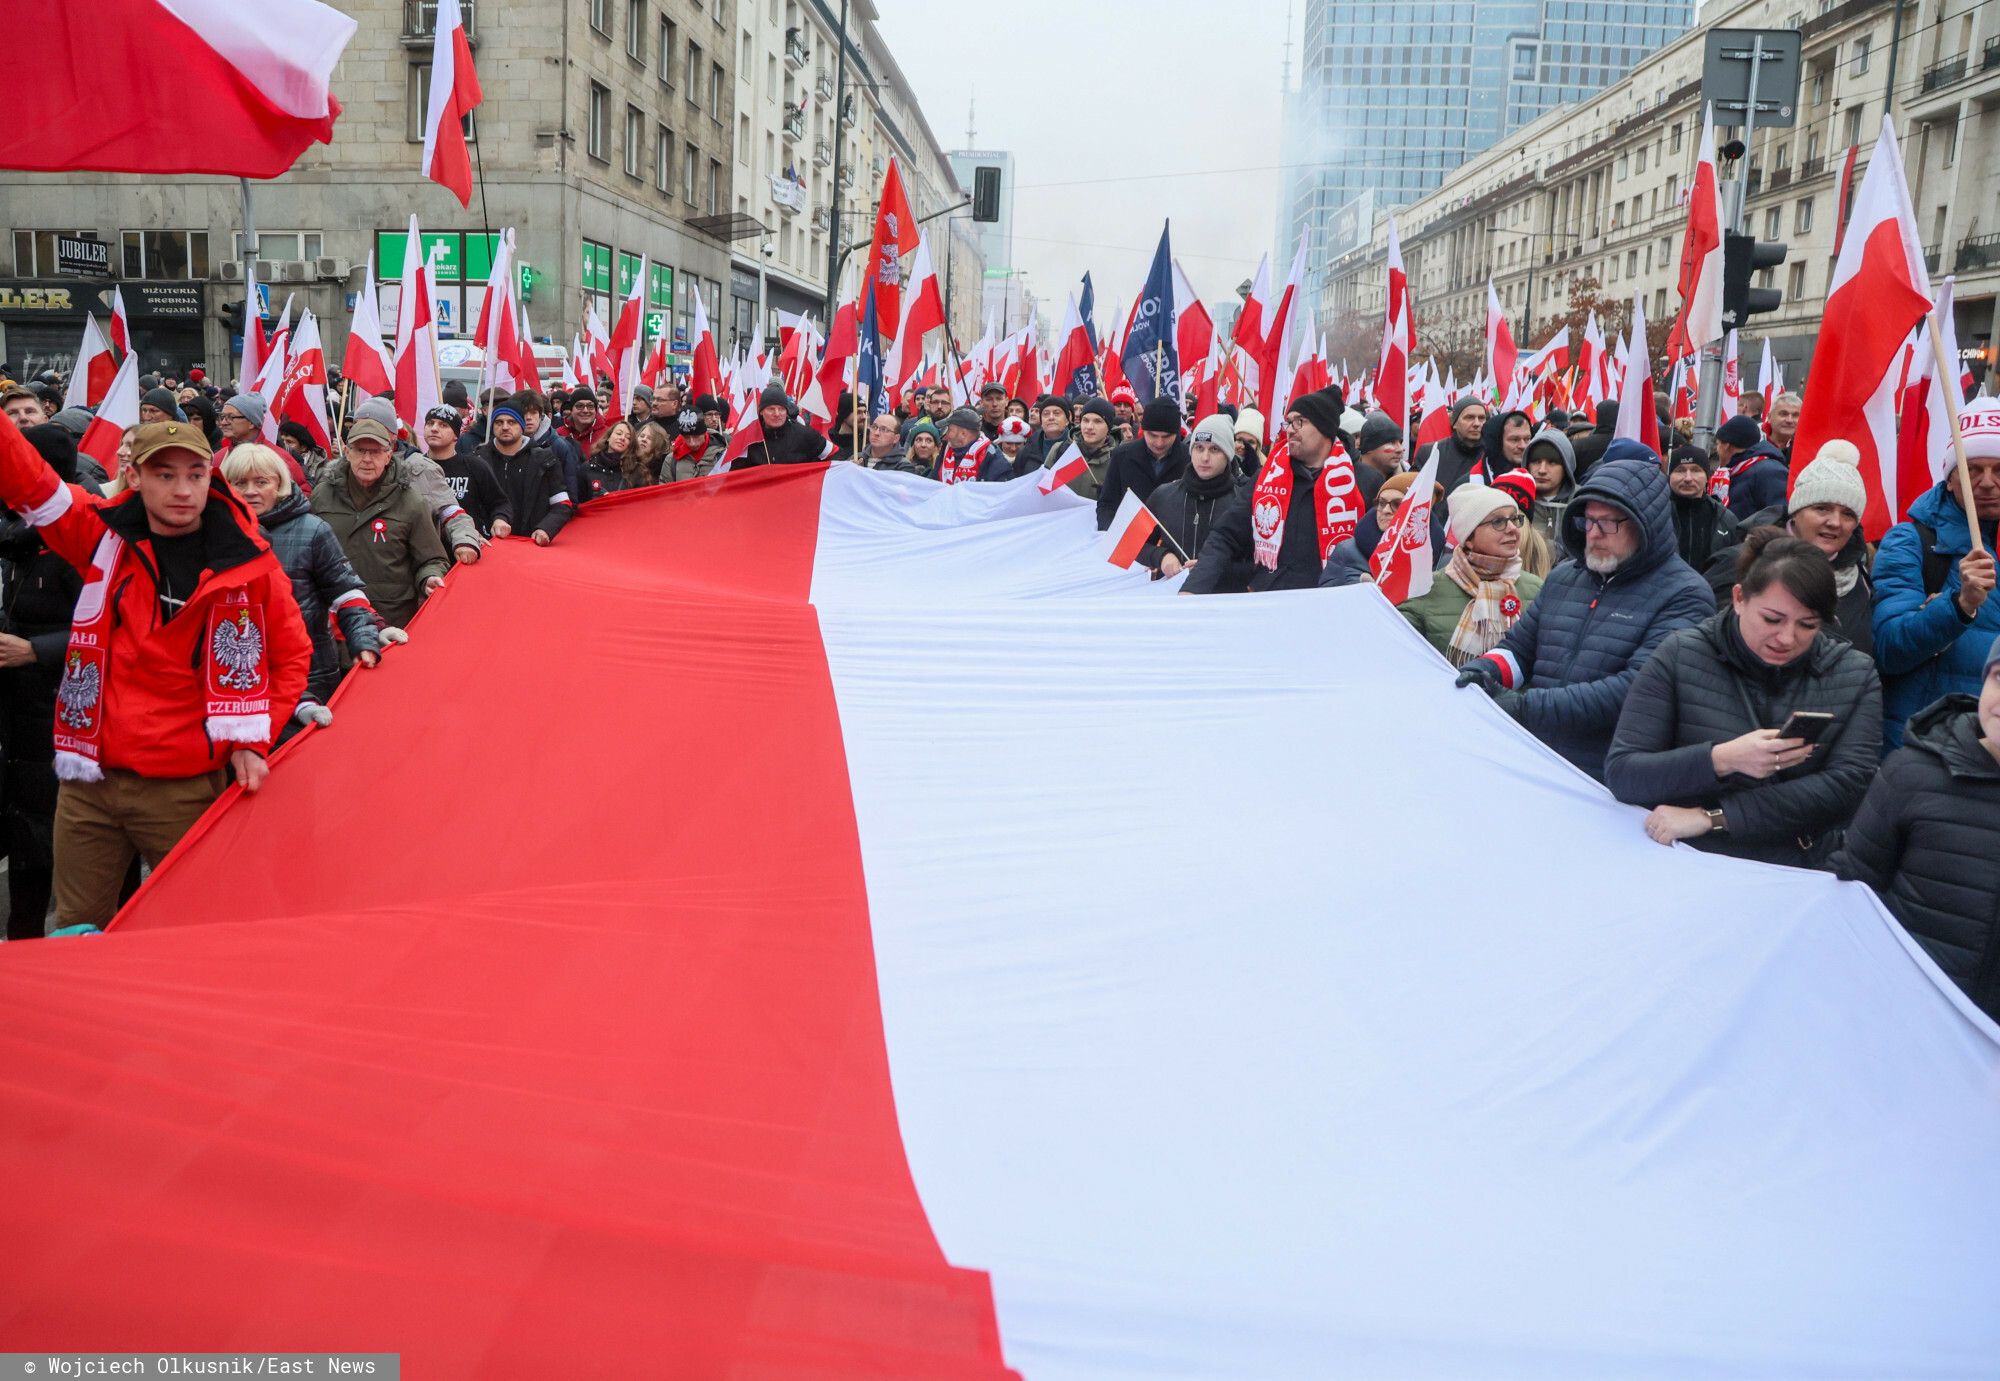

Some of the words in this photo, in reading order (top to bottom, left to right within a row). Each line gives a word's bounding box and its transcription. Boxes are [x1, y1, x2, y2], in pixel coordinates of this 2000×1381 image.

[60, 239, 108, 263] JUBILER
[142, 287, 198, 295] BIŻUTERIA
[152, 306, 198, 314] ZEGARKI
[1321, 524, 1354, 536] BIAŁ
[70, 630, 98, 646] AŁO
[206, 698, 270, 715] CZERWONI
